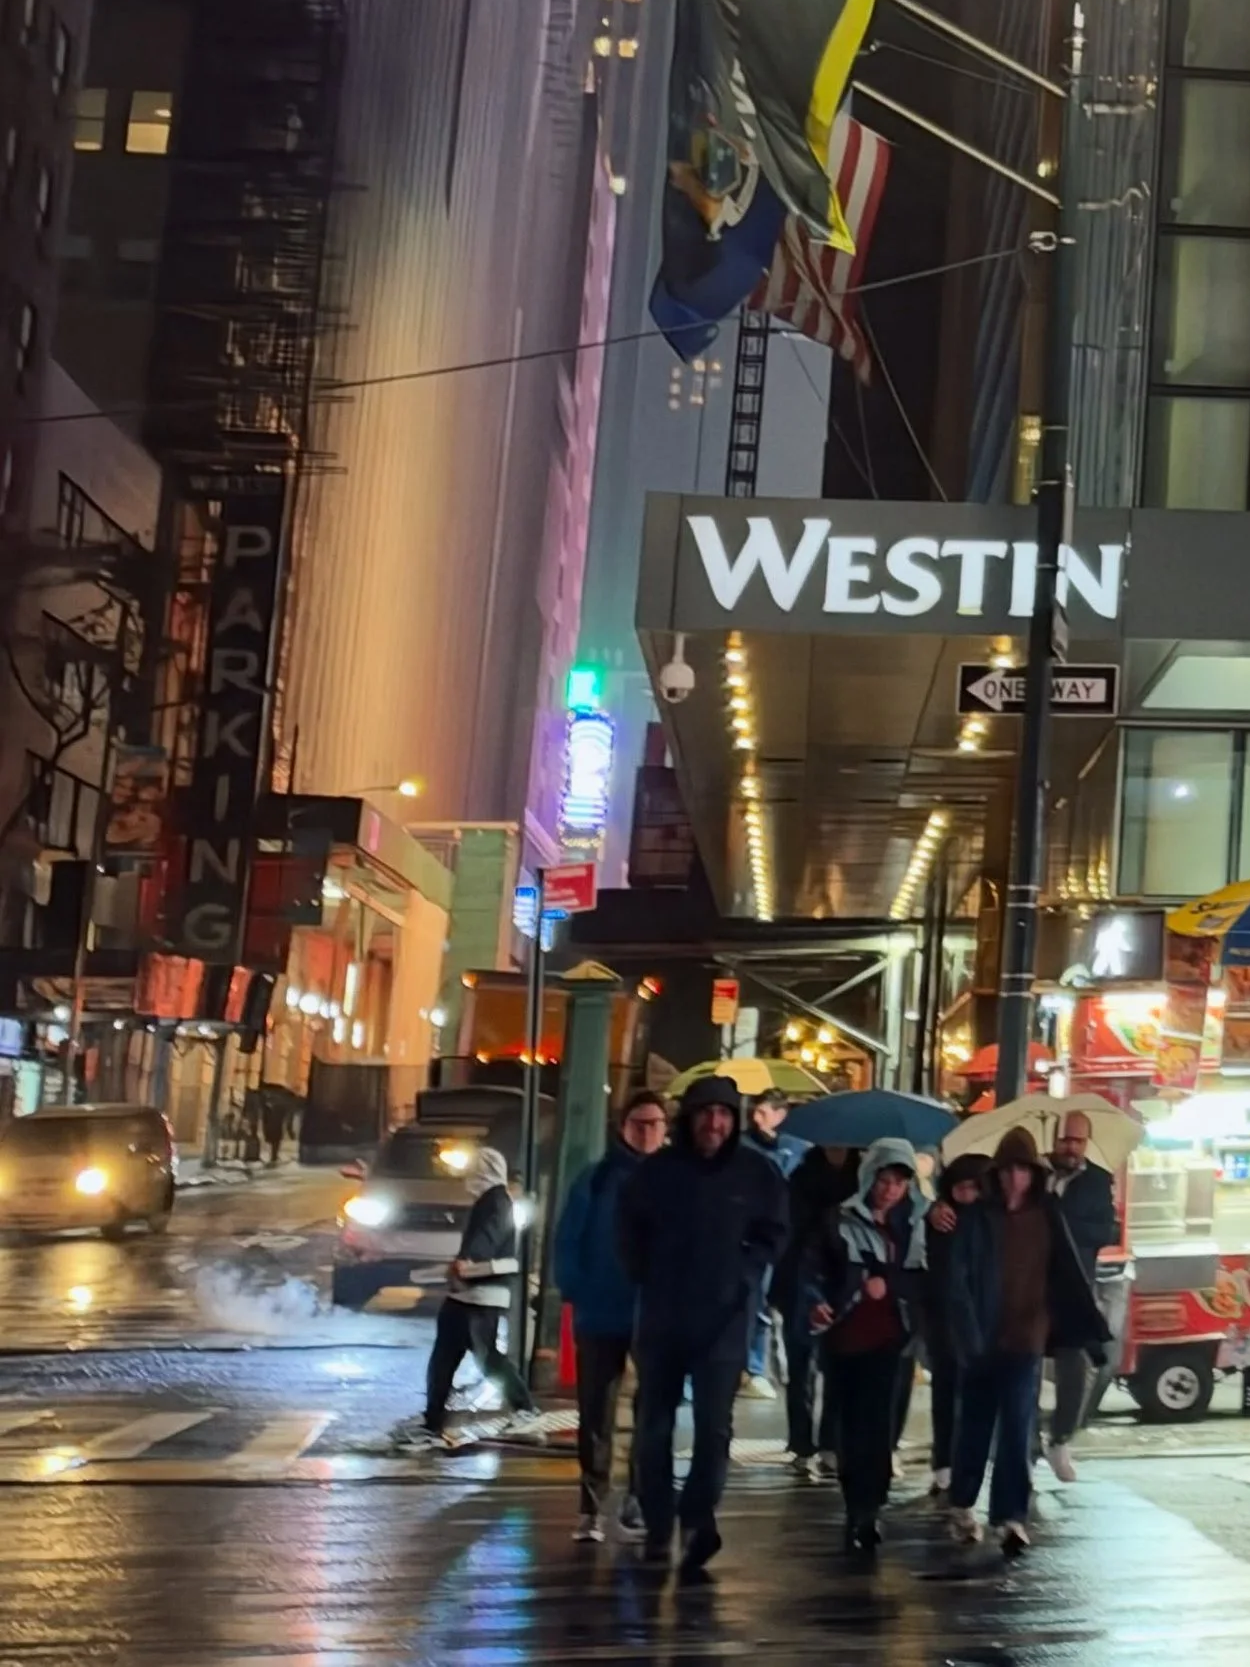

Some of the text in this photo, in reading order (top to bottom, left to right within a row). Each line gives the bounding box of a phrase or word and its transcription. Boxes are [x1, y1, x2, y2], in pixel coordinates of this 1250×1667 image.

[686, 515, 1124, 619] WESTIN
[182, 525, 272, 950] PARKING
[983, 679, 1026, 700] ONE
